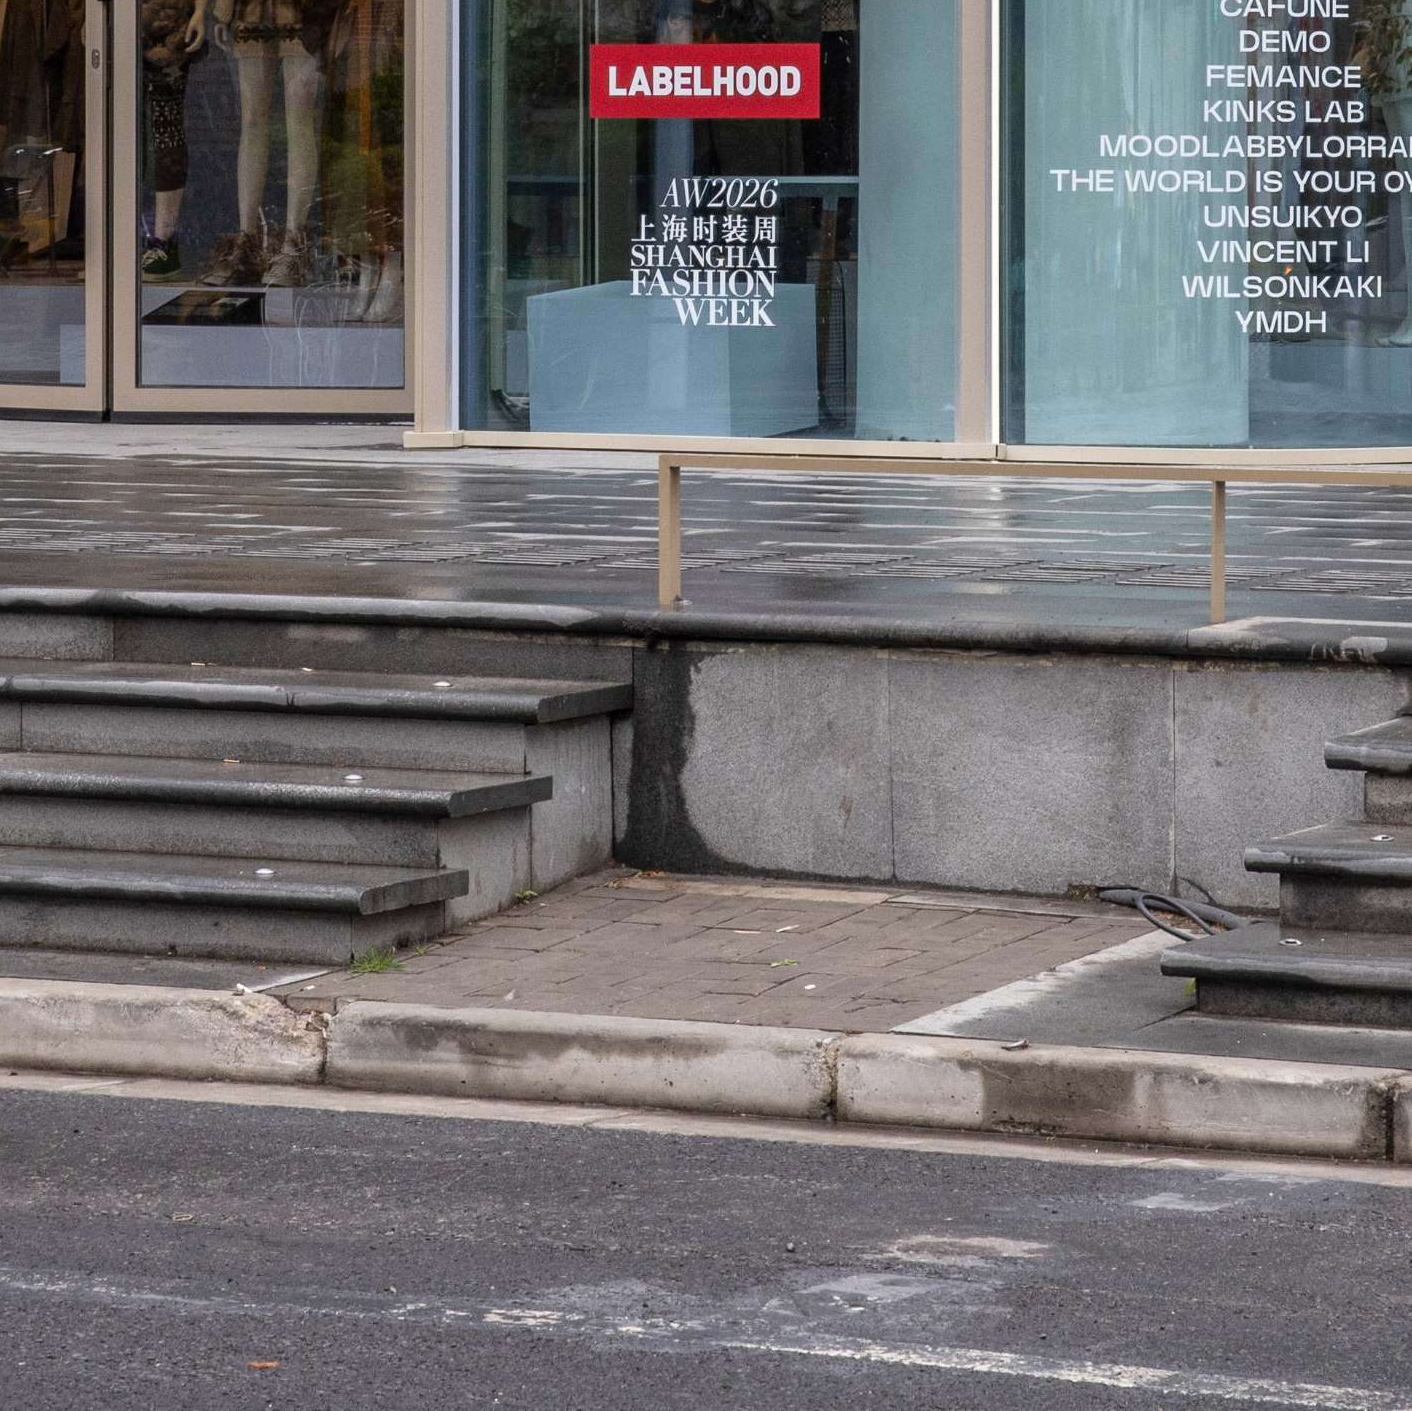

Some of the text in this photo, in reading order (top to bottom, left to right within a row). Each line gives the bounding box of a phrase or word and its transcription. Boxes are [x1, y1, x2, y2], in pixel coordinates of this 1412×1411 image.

[1239, 29, 1331, 53] DEMO
[608, 65, 801, 96] LABELHOOD
[1206, 64, 1361, 88] FEMANCE
[1203, 99, 1364, 123] KINKS LAB
[660, 178, 779, 208] AW2026
[1049, 169, 1115, 193] THE
[1124, 170, 1247, 193] WORLD
[1255, 170, 1283, 193] IS
[1292, 170, 1376, 193] YOUR
[1203, 204, 1362, 228] UNSUIKYO
[631, 214, 776, 244] 上海时装周
[630, 244, 777, 269] SHANGHAI
[1196, 240, 1369, 263] VINCENT LI
[630, 268, 777, 298] FASHION
[1181, 275, 1382, 299] WILSONKAKI
[673, 297, 775, 327] WEEK
[1234, 310, 1327, 333] YMDH
